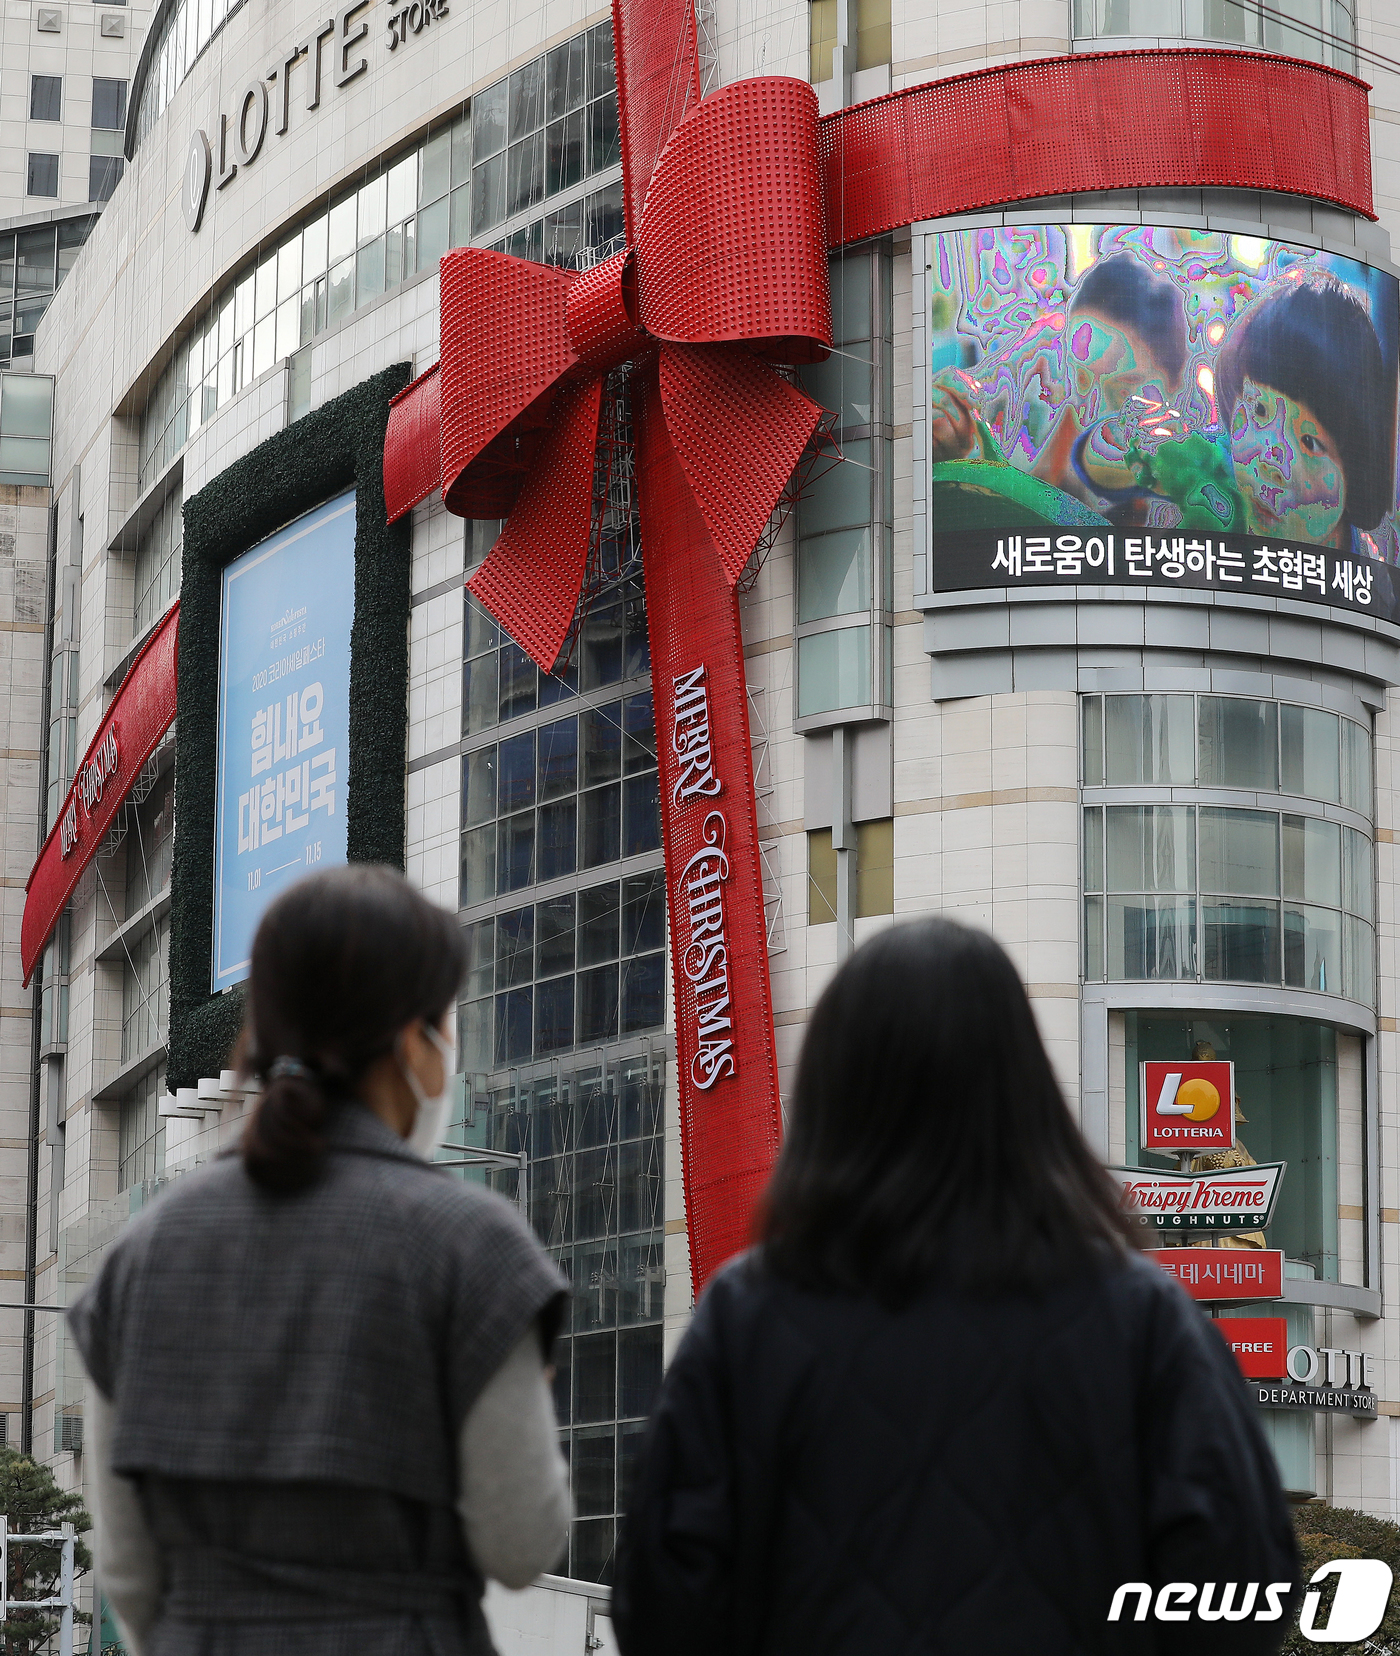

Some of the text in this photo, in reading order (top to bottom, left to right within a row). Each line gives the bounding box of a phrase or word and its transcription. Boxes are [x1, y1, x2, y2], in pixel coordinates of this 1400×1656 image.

[214, 0, 369, 191] LOTTE
[991, 534, 1373, 605] 새로움이 탄생하는 초협력 세상
[252, 636, 326, 692] 2020 코리아세일페스타
[251, 681, 324, 778] 힘내요
[238, 747, 337, 856] 대한민국
[247, 841, 322, 892] 11.01 11.15
[672, 662, 736, 1090] MERRY CHRISTMAS
[1153, 1127, 1224, 1138] LOTTERIA
[1119, 1180, 1268, 1213] Krispy Kreme
[1126, 1215, 1260, 1225] OUGHNUTS
[1231, 1342, 1273, 1353] FREE
[1286, 1345, 1375, 1388] OTTE
[1259, 1388, 1375, 1410] DEPARTMENT STORE
